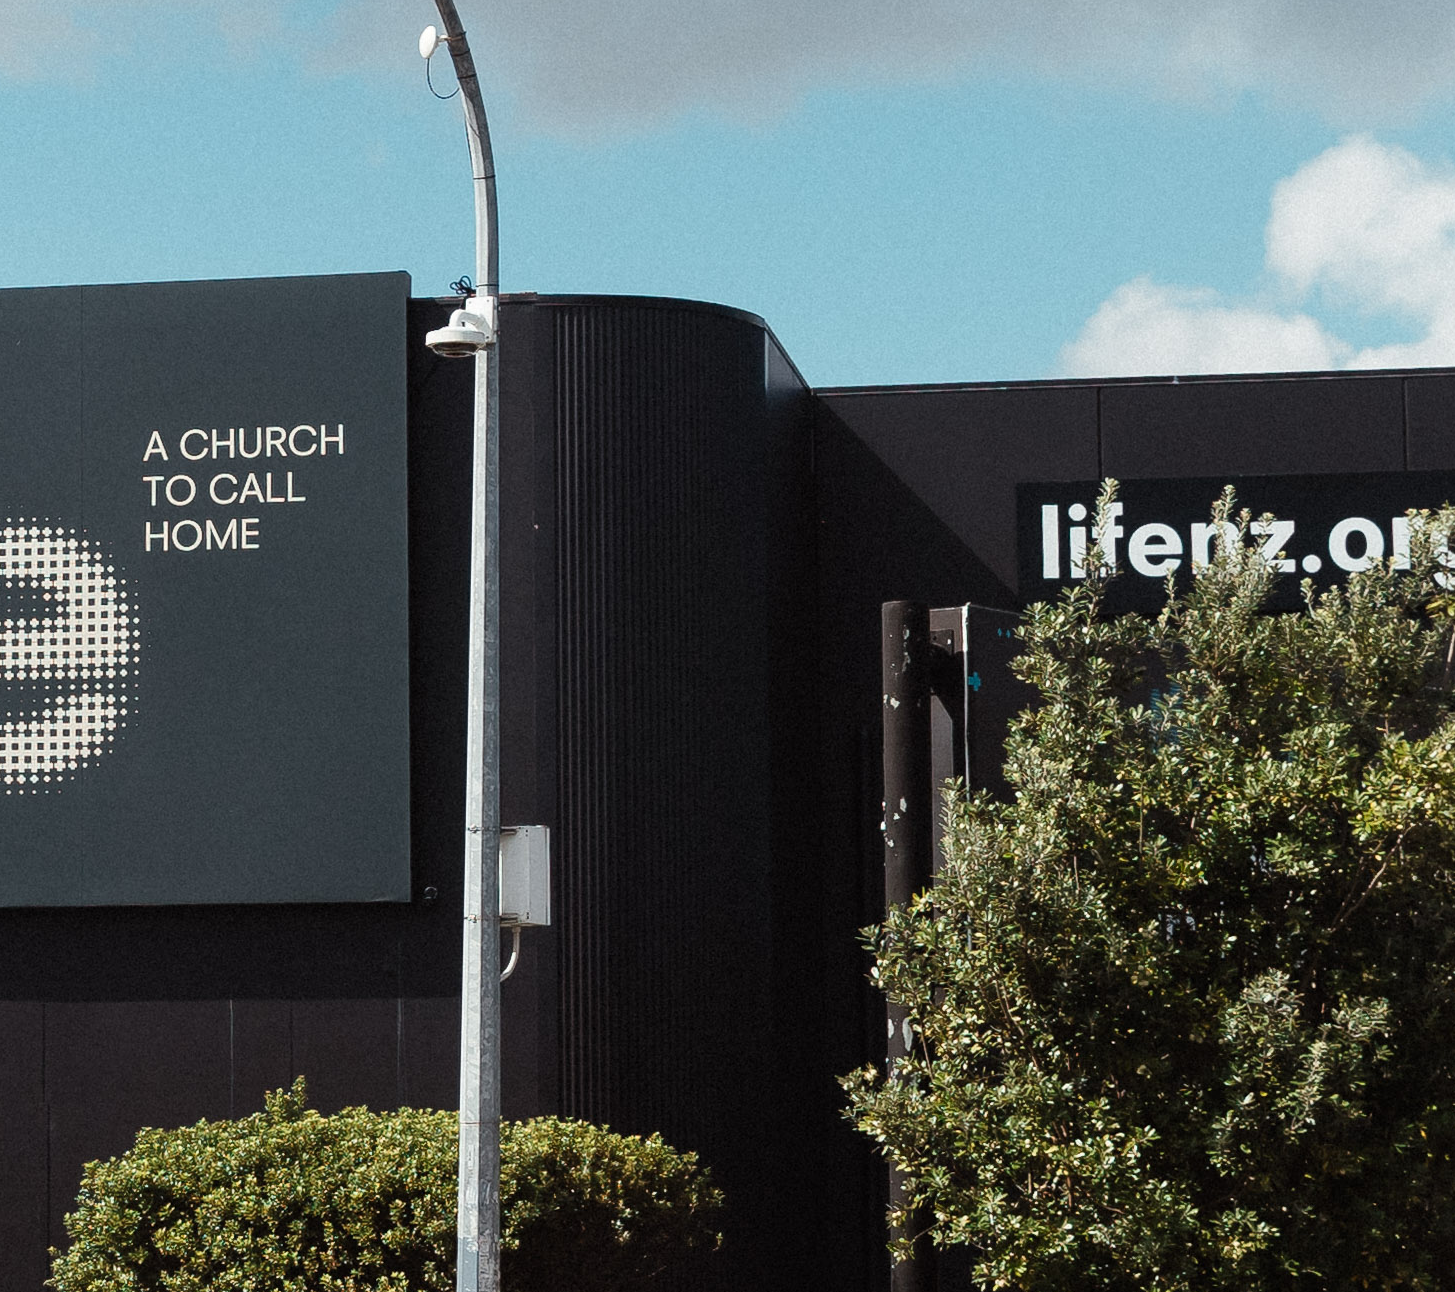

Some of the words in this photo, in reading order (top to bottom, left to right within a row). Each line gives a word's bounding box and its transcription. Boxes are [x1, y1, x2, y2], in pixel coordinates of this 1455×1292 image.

[142, 430, 169, 462] A
[179, 423, 345, 461] CHURCH
[142, 474, 197, 507] TO
[209, 471, 307, 505] CALL
[145, 518, 260, 552] HOME
